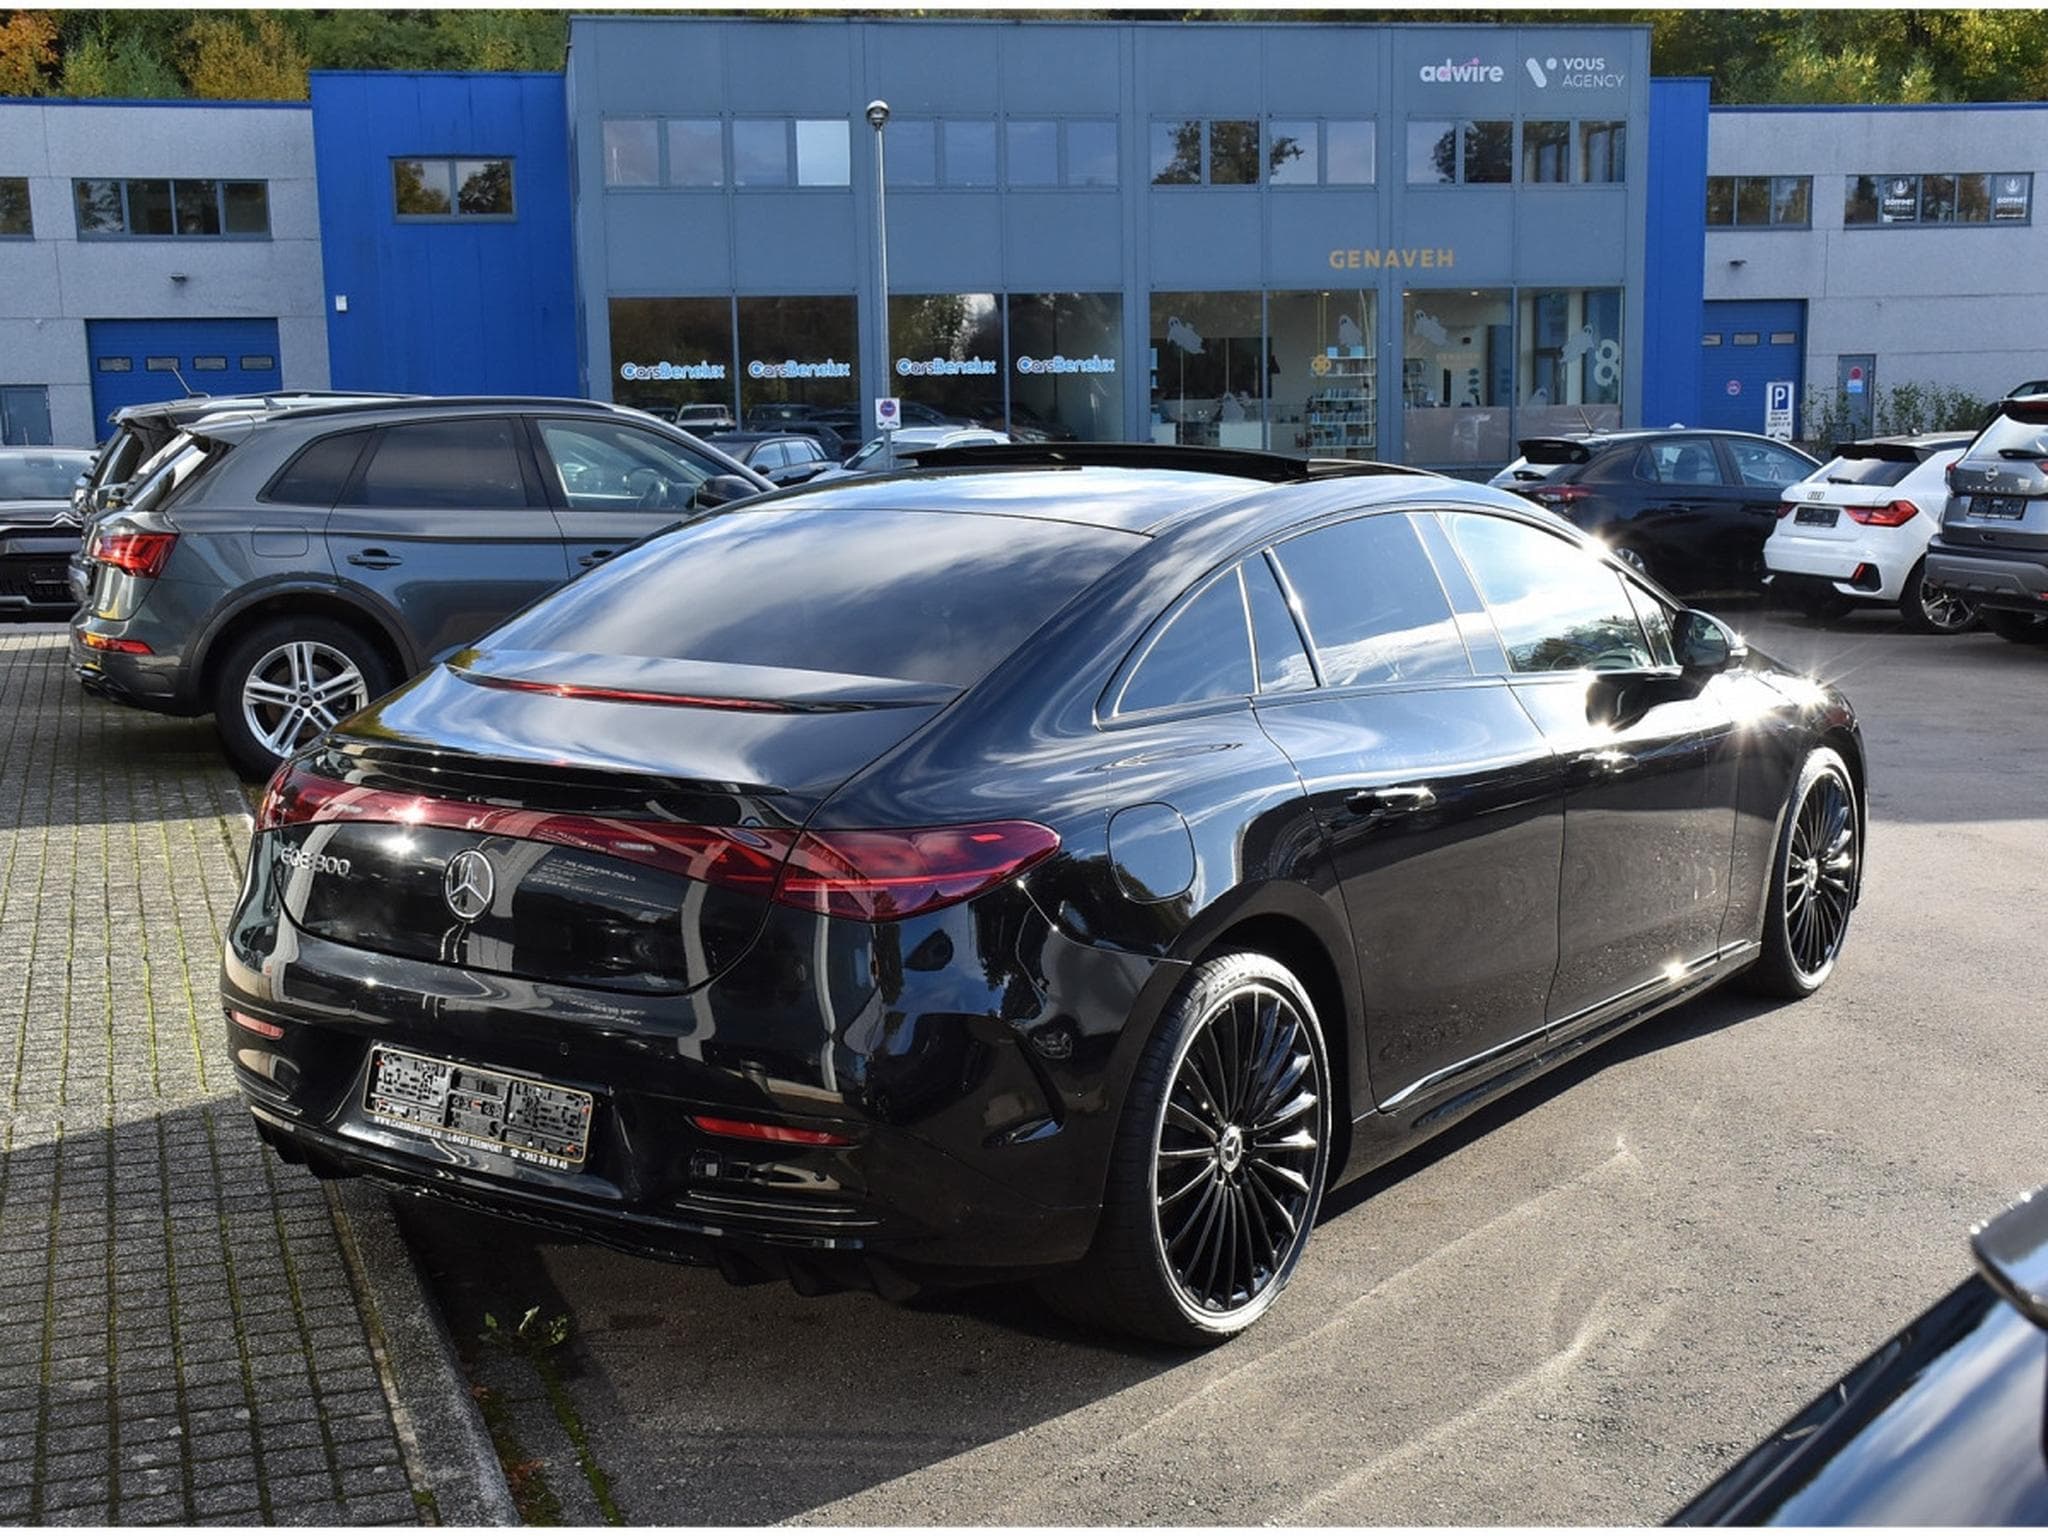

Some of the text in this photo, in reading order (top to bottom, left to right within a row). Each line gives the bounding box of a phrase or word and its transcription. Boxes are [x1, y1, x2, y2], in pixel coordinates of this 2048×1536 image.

[1419, 58, 1504, 82] adwire
[1562, 57, 1605, 71] VOUS
[1562, 74, 1625, 88] AGENCY
[1329, 249, 1455, 269] GENAVEH
[620, 360, 726, 380] CarsBenelux
[748, 358, 850, 378] CarsBenelux
[896, 356, 997, 376] CarsBenelux
[1016, 355, 1115, 374] CarsBenelux
[315, 854, 351, 875] 300
